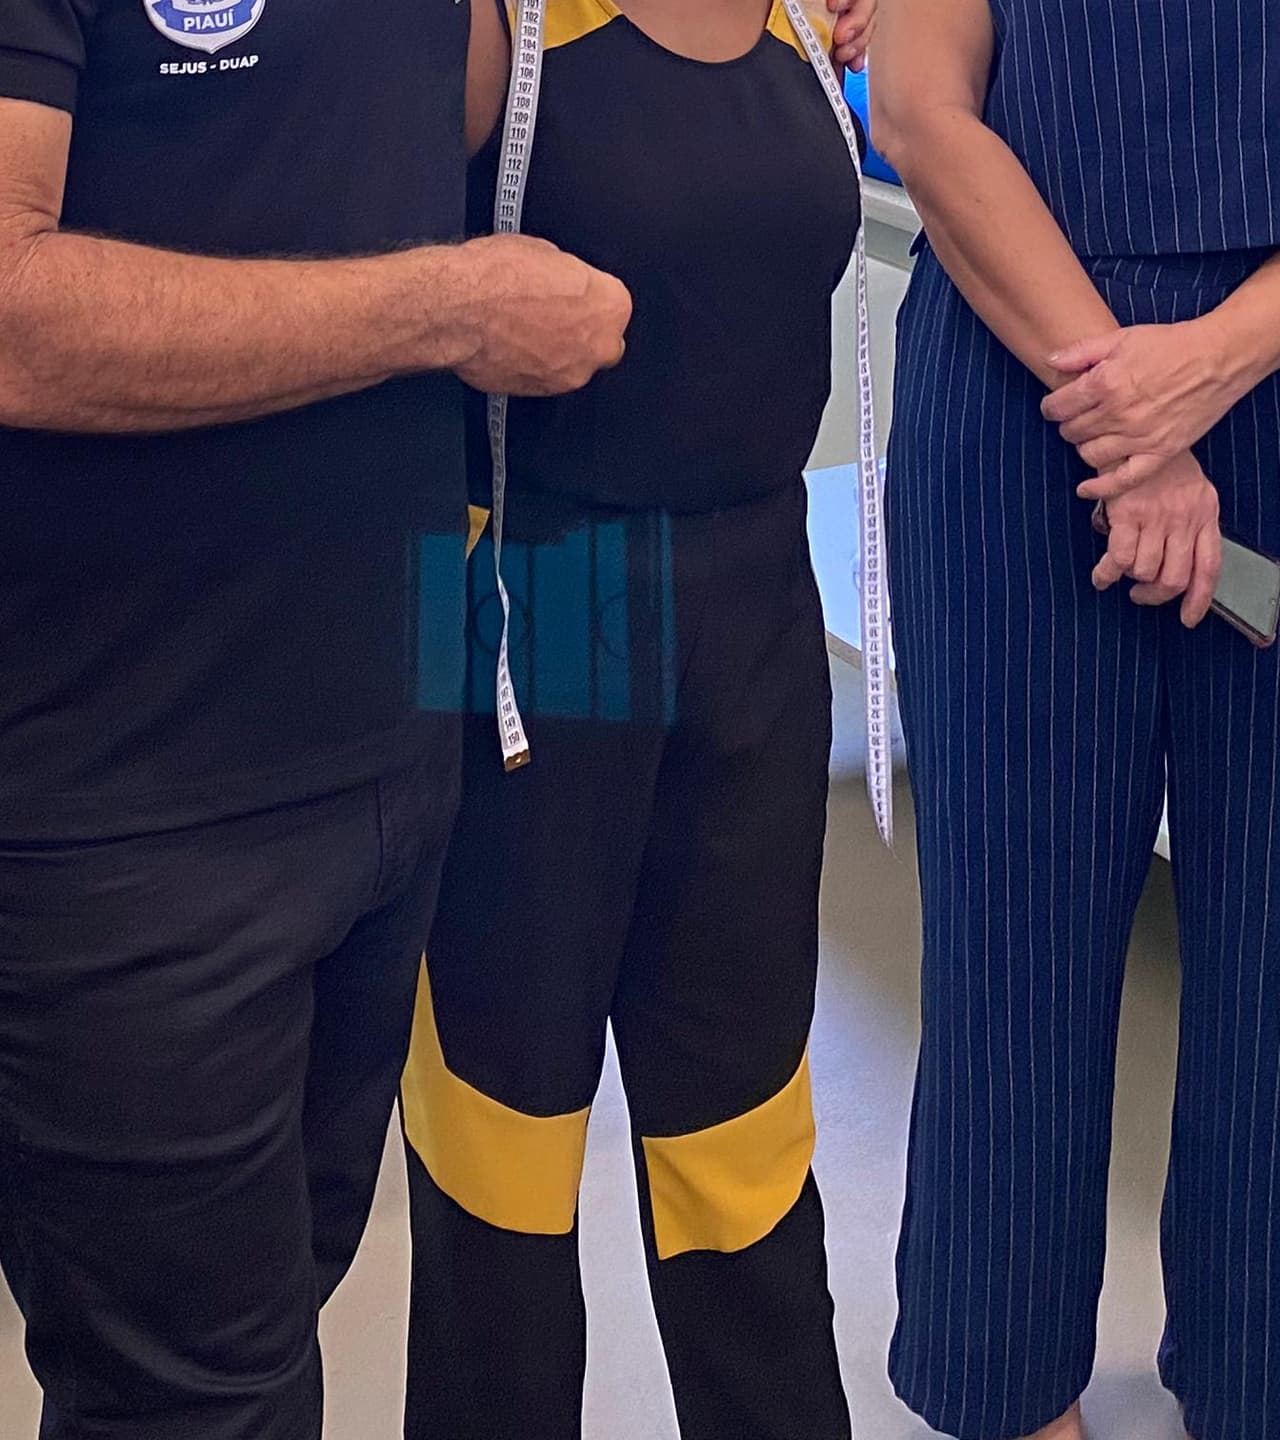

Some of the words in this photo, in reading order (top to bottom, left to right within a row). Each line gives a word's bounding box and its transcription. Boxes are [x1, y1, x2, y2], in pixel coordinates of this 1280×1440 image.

[183, 9, 234, 31] PIAUÍ
[525, 11, 539, 23] 102
[523, 25, 537, 37] 103
[523, 39, 536, 50] 104
[522, 52, 535, 64] 105
[160, 61, 207, 74] SEJUS
[220, 55, 259, 70] DUAP
[520, 66, 534, 79] 106
[518, 81, 533, 93] 107
[516, 96, 531, 108] 108
[513, 111, 529, 124] 109
[511, 127, 527, 140] 110
[510, 142, 523, 154] 111
[508, 158, 522, 170] 112
[506, 173, 519, 185] 113
[503, 189, 516, 200] 114
[502, 204, 514, 216] 115
[500, 220, 513, 232] 116
[870, 641, 878, 652] 17
[871, 708, 880, 719] 12
[871, 723, 880, 733] 11
